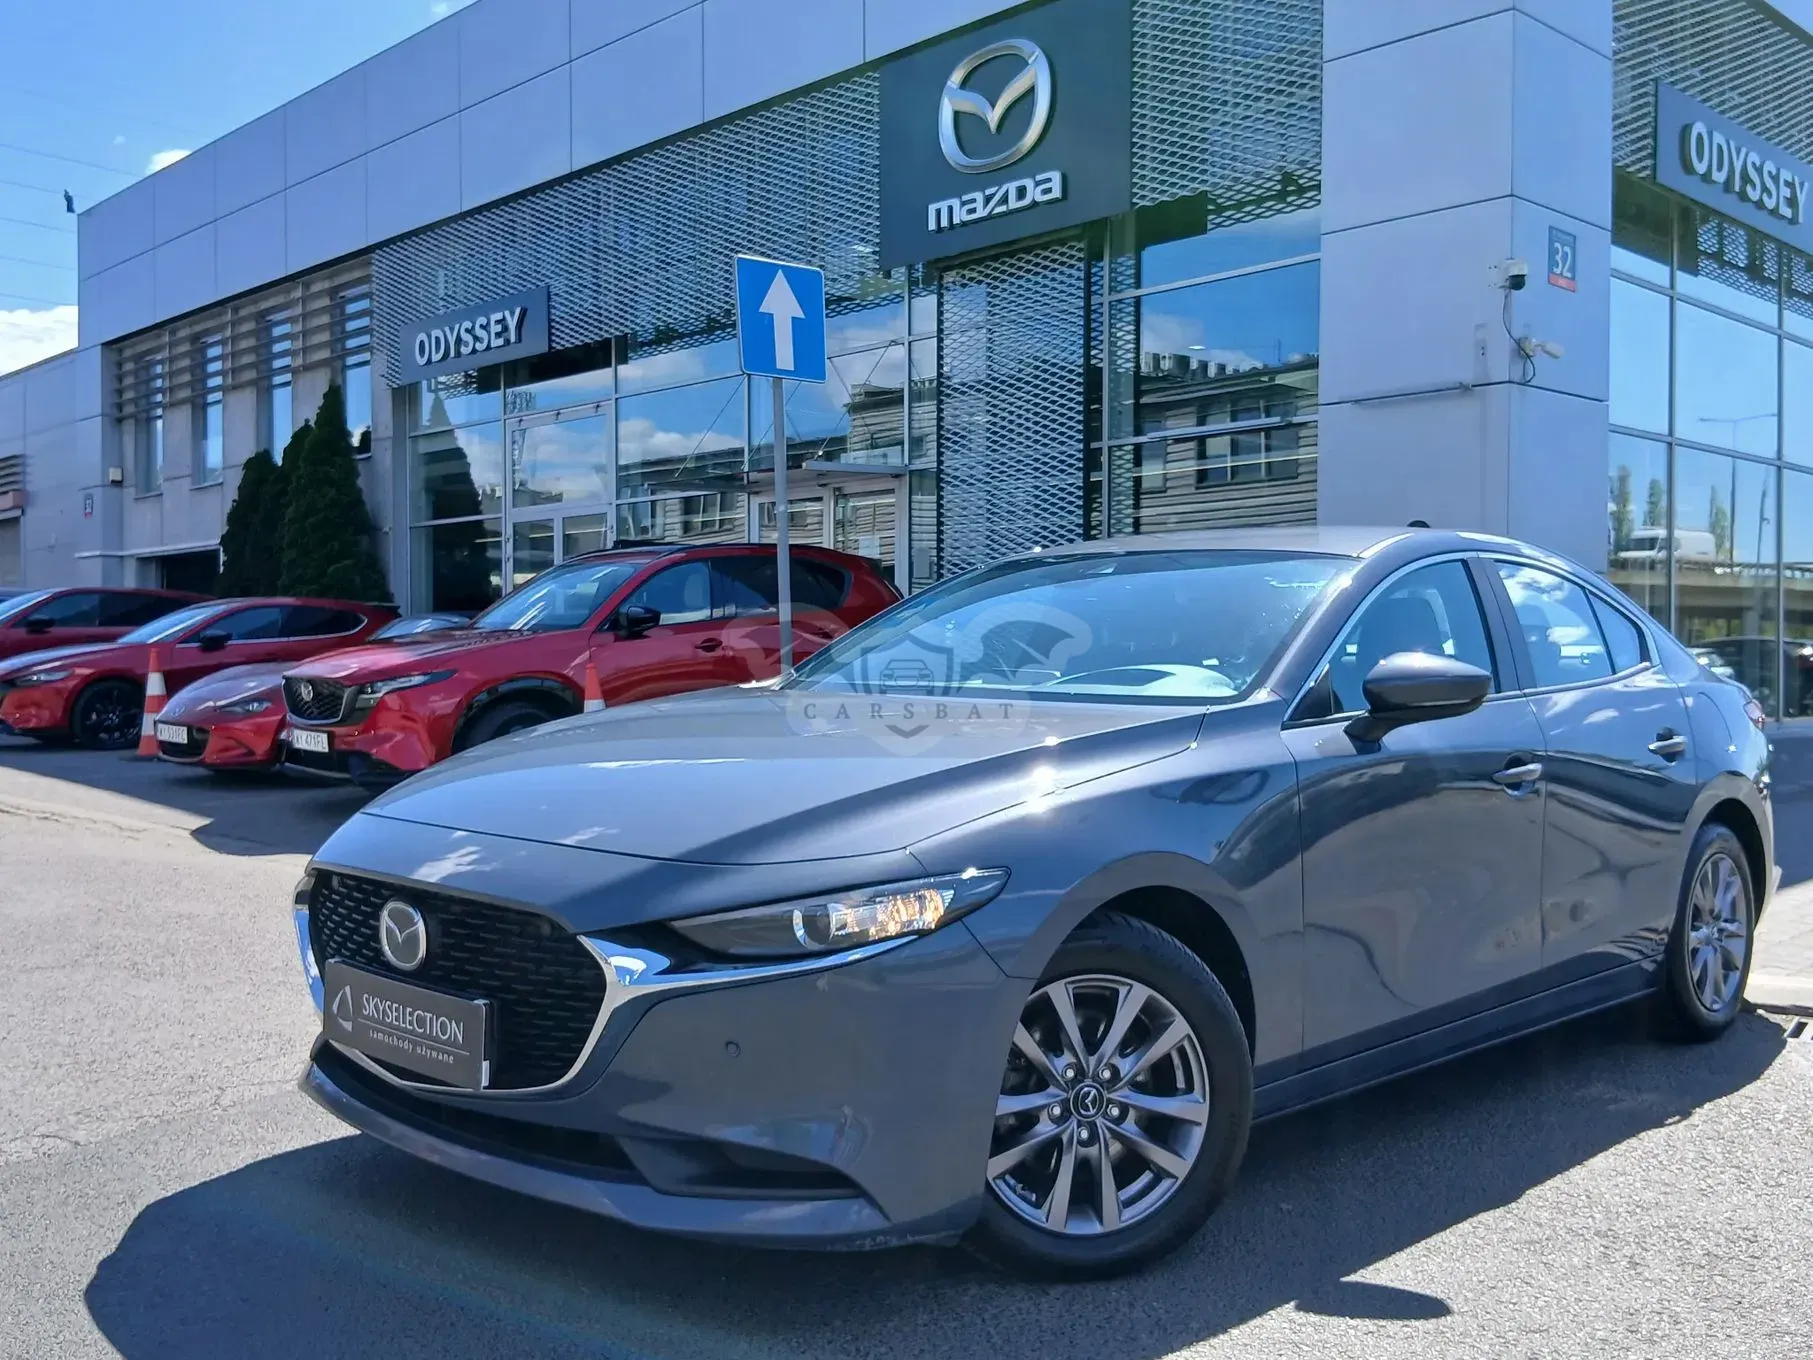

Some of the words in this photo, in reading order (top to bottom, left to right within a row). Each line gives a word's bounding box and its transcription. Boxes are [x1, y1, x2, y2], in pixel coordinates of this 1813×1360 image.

[1689, 121, 1809, 223] ODYSSEY
[1553, 242, 1572, 278] 32
[415, 306, 522, 366] ODYSSEY
[362, 993, 464, 1044] SKYSELECTION
[369, 1029, 413, 1053] samochody
[416, 1045, 455, 1064] używane
